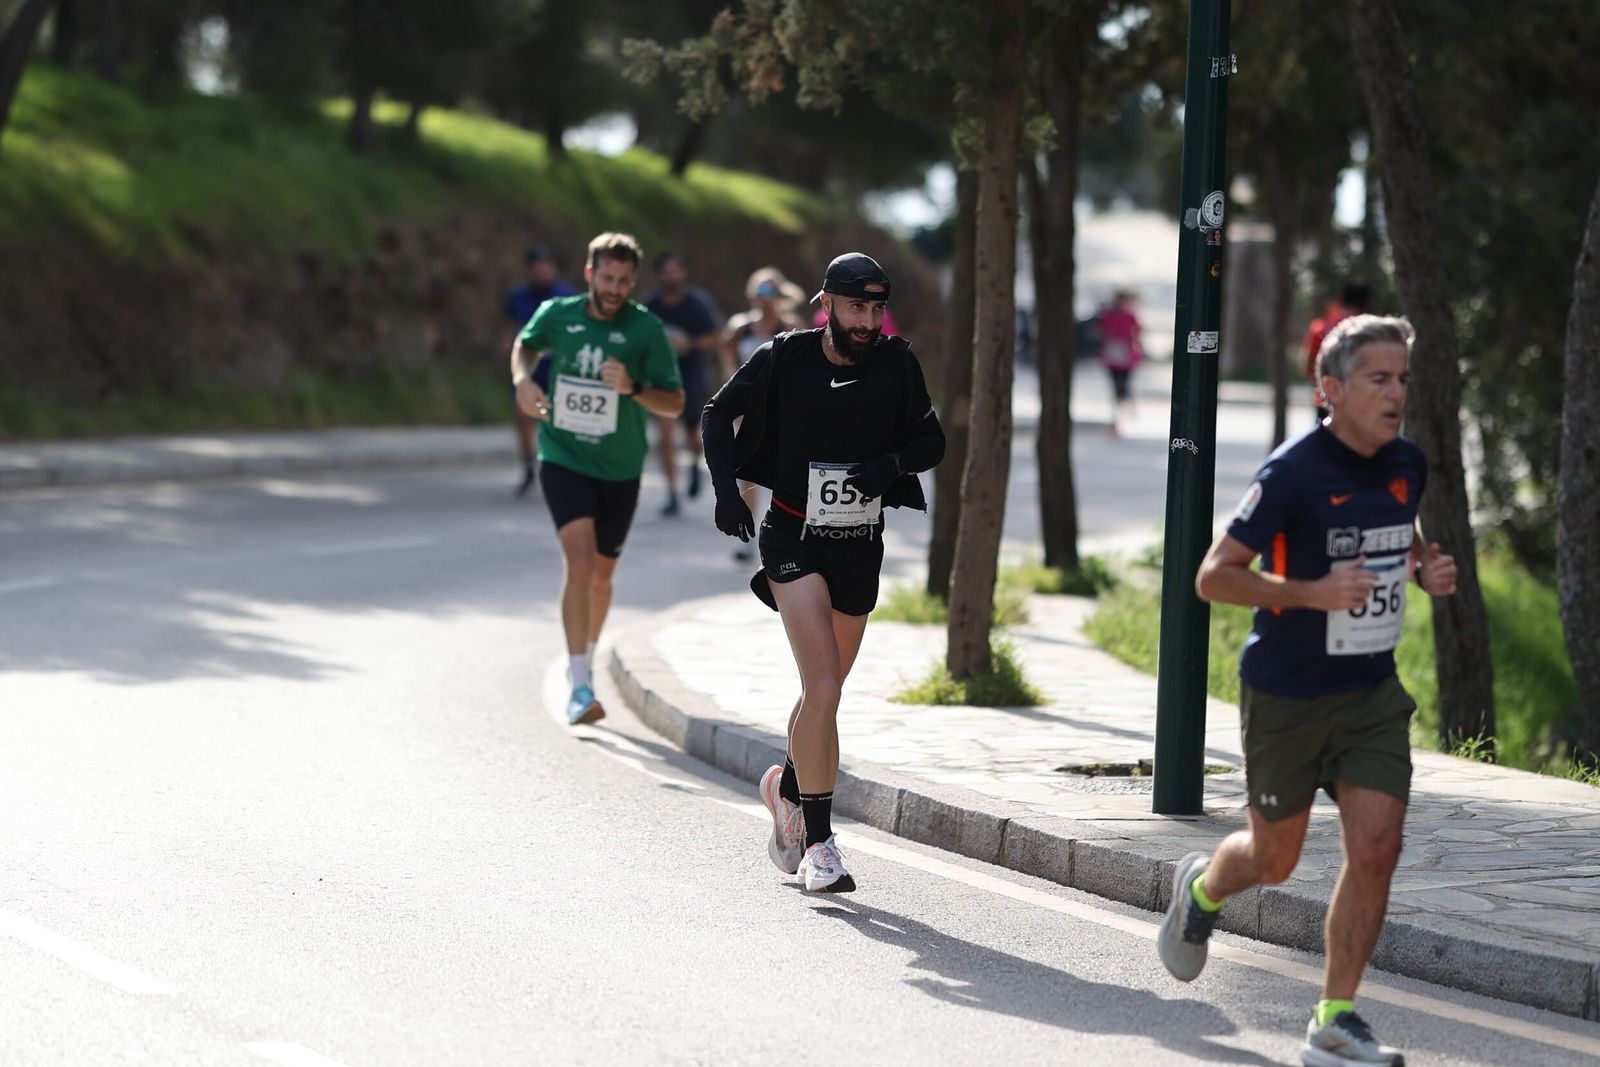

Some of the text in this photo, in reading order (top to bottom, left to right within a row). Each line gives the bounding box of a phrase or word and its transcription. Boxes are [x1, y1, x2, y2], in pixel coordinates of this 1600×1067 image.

[565, 392, 607, 415] 682
[820, 480, 873, 505] 65
[809, 526, 868, 539] WONG
